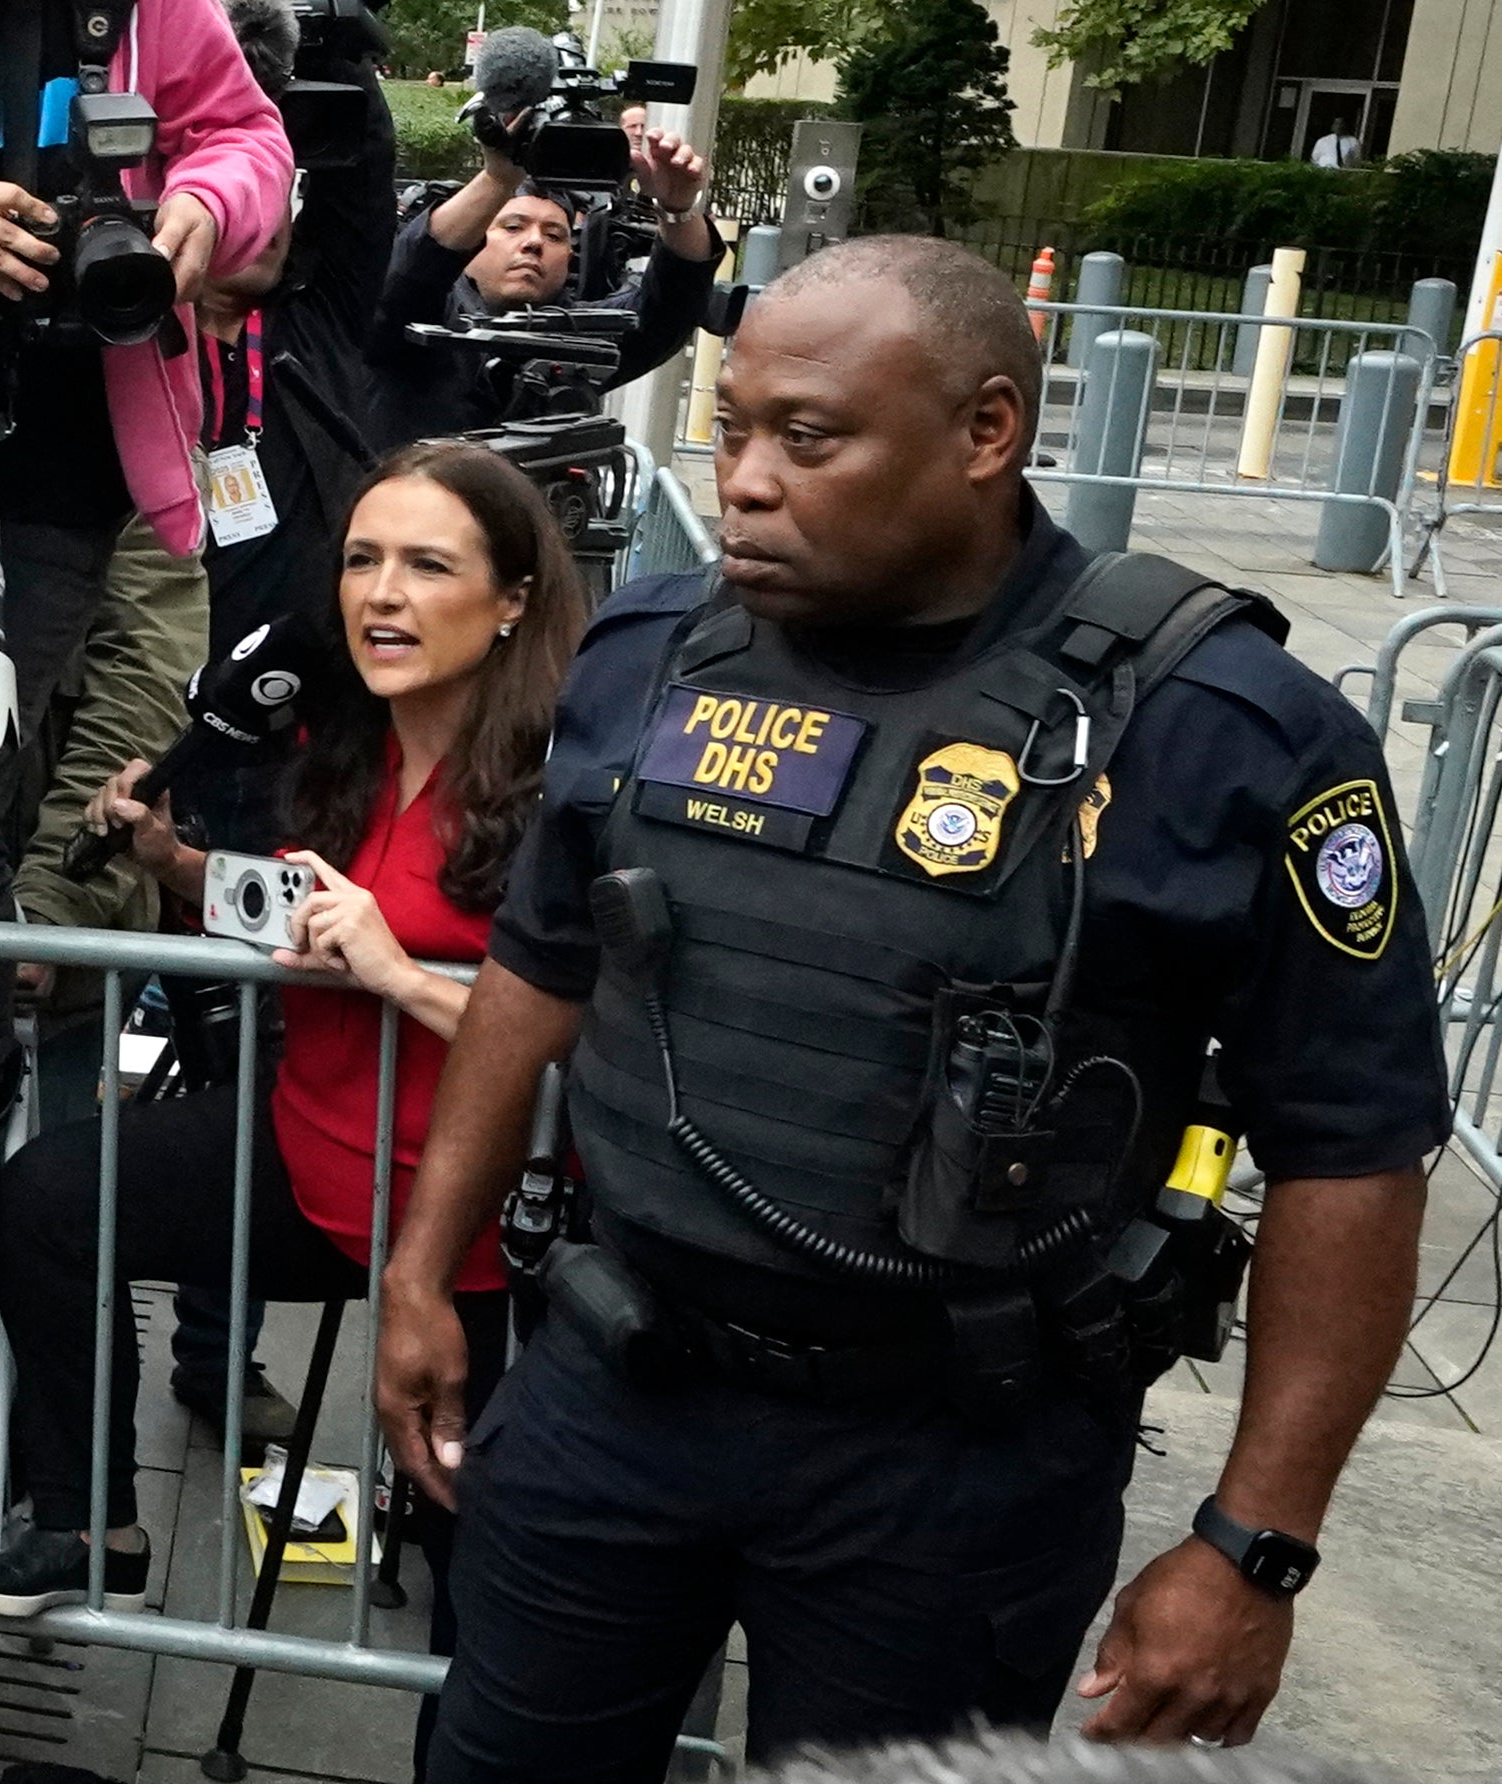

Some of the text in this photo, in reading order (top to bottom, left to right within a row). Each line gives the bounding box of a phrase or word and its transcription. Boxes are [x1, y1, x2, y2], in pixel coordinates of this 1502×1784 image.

[203, 712, 260, 744] CBS NEWS
[683, 694, 831, 755] POLICE
[693, 742, 779, 794] DHS
[950, 774, 984, 791] DHS
[686, 799, 765, 835] WELSH
[1289, 792, 1373, 853] POLICE
[918, 846, 959, 864] POLICE
